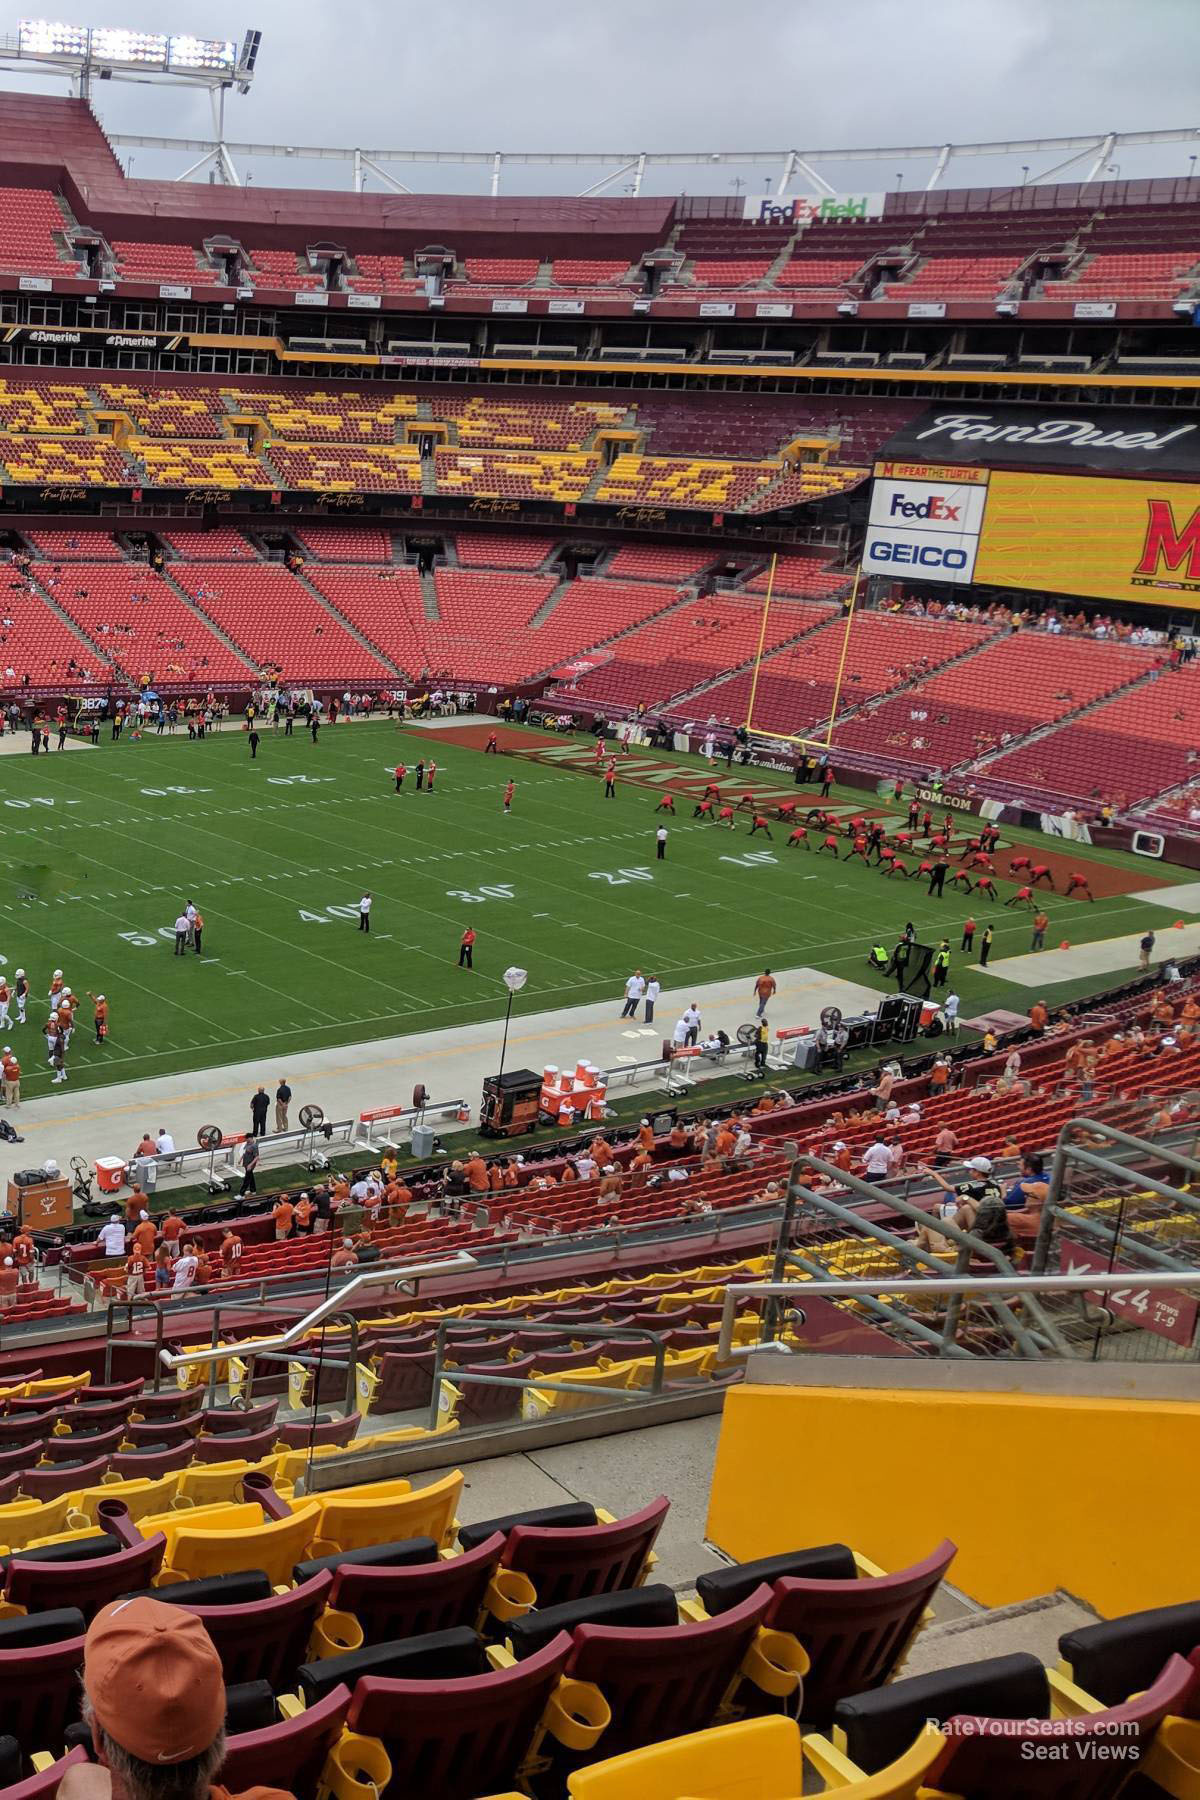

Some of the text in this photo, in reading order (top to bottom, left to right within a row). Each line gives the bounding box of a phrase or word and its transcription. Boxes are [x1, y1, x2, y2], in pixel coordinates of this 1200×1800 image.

[760, 197, 867, 219] FedExField
[37, 331, 81, 343] Ameritel
[114, 335, 157, 347] Ameritel
[916, 414, 1198, 450] FanDuel
[883, 463, 894, 477] M
[889, 493, 963, 522] FedEx
[869, 541, 968, 569] GEICO
[719, 851, 780, 868] 10
[588, 867, 654, 885] 20
[446, 884, 515, 903] 30
[299, 903, 363, 924] 40
[117, 927, 179, 947] 50
[542, 1096, 549, 1108] G
[111, 1171, 122, 1184] G
[20, 1243, 28, 1257] 7
[231, 1243, 242, 1258] 10
[132, 1262, 144, 1275] 12
[187, 1265, 196, 1278] 8
[1153, 1310, 1177, 1328] 1-9
